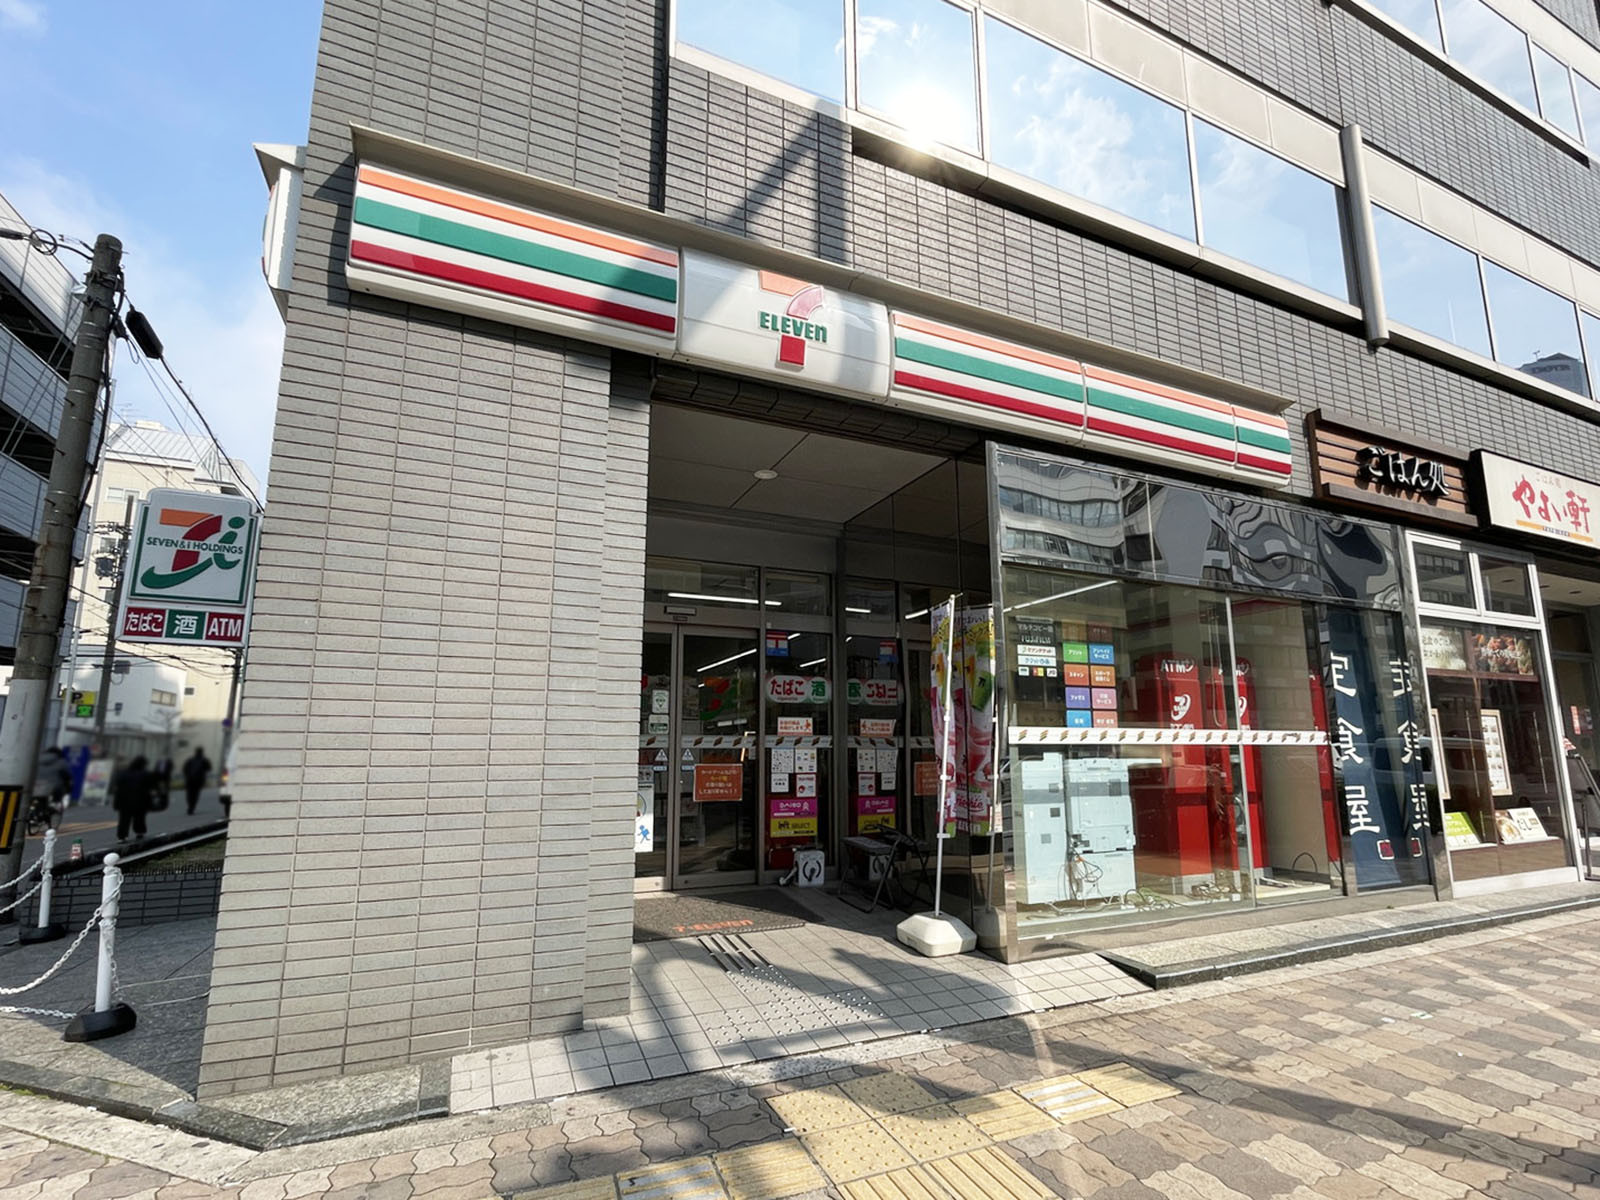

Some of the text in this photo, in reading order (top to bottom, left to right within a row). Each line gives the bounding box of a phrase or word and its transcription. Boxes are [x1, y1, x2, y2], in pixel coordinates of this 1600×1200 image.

[1366, 446, 1450, 497] ごはん処
[1511, 474, 1591, 534] やよい軒
[193, 541, 244, 555] HOLDINGS
[125, 611, 242, 638] たばこ 酒 ATM
[770, 679, 826, 697] たばこ 酒
